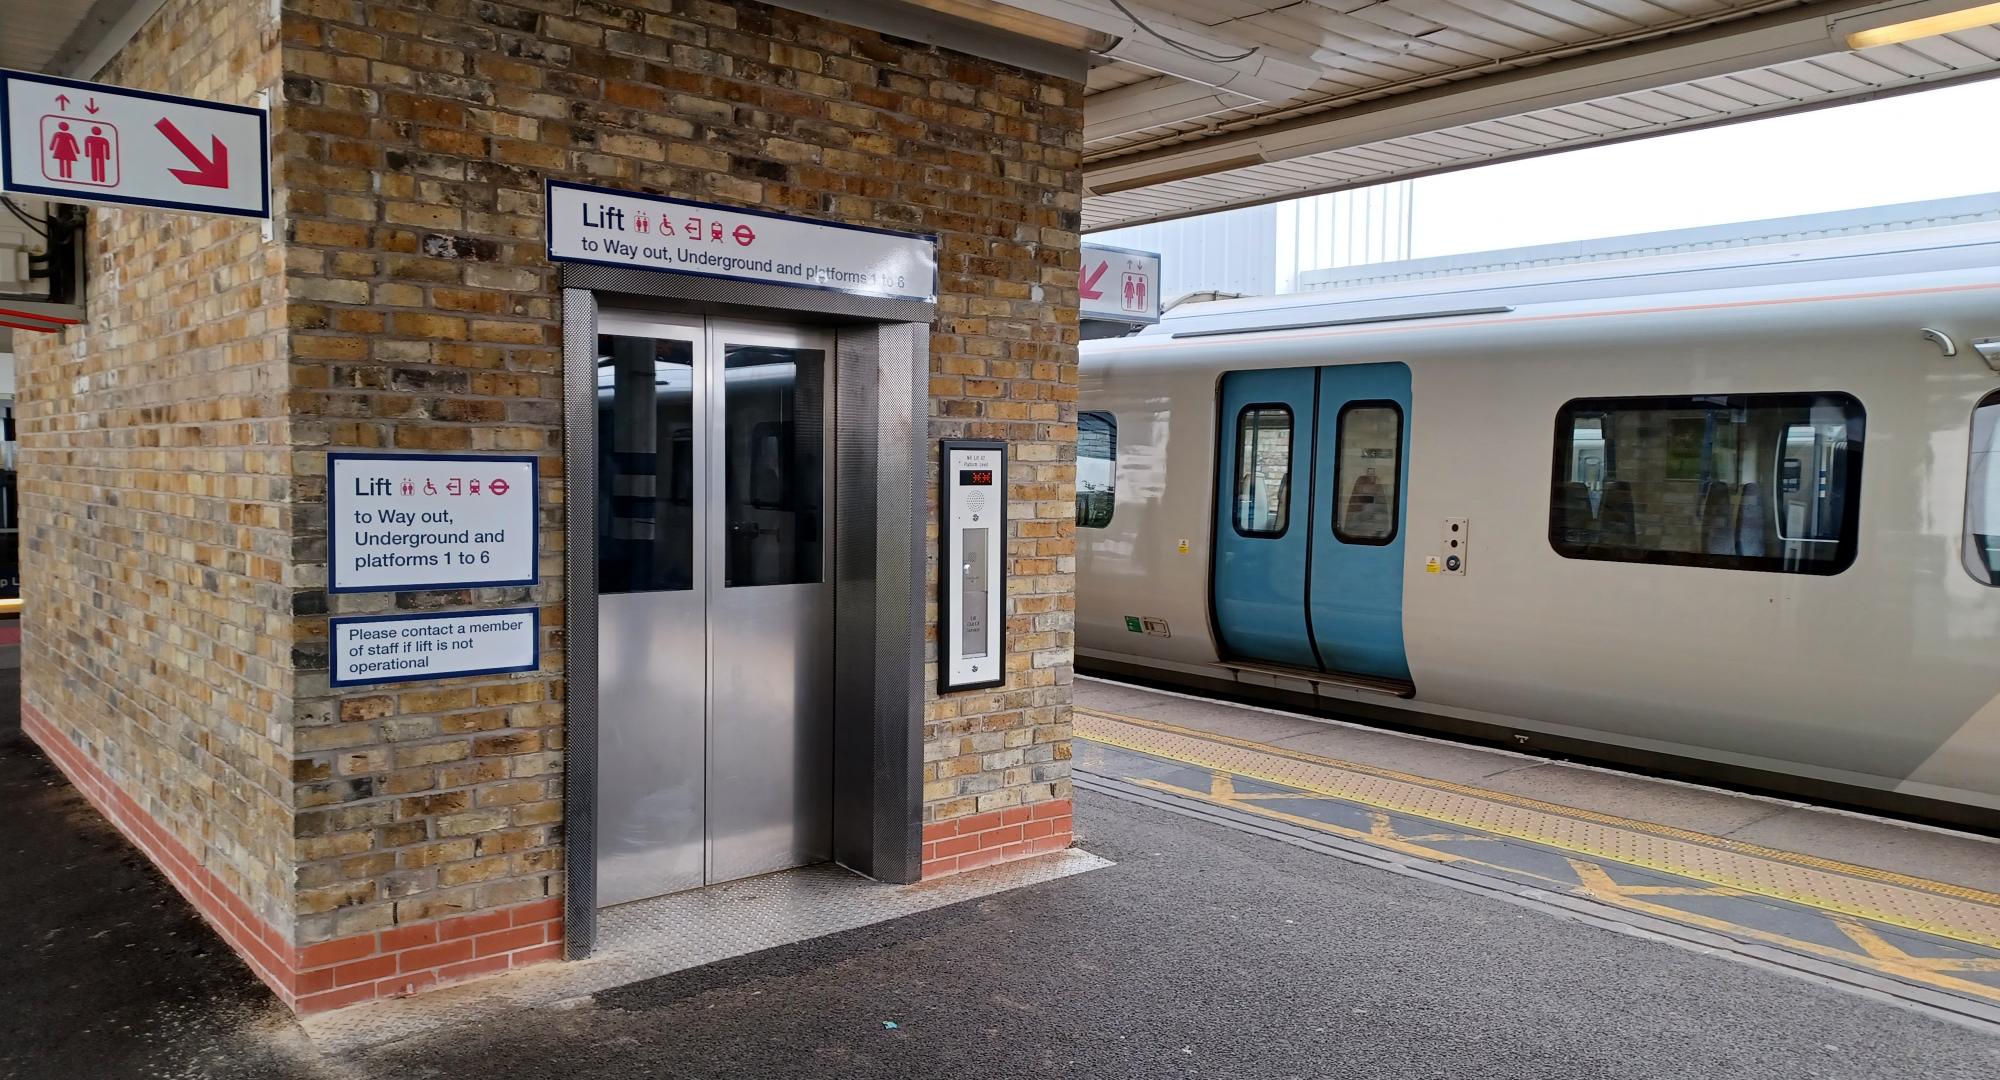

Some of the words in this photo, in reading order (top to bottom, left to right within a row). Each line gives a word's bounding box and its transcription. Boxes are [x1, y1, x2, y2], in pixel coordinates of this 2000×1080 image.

[582, 202, 625, 232] Lift
[582, 236, 598, 253] to
[603, 238, 638, 260] Way
[642, 245, 673, 264] out,
[677, 248, 772, 275] Underground
[776, 260, 802, 277] and
[806, 265, 867, 284] platforms
[870, 273, 876, 286] 1
[882, 275, 895, 288] to
[897, 276, 905, 289] 6
[355, 477, 392, 496] Lift
[354, 510, 372, 524] to
[378, 510, 415, 526] Way
[421, 509, 453, 524] out,
[355, 531, 469, 547] Underground
[474, 530, 505, 543] and
[355, 552, 438, 571] platforms
[444, 552, 452, 565] 1
[458, 552, 475, 565] to
[480, 551, 490, 564] 6
[349, 627, 397, 641] Please
[401, 623, 453, 637] contact
[457, 624, 466, 634] a
[469, 620, 523, 633] member
[349, 645, 364, 656] of
[368, 642, 399, 656] staff
[403, 641, 412, 654] if
[415, 640, 433, 652] lift
[436, 639, 448, 651] is
[452, 638, 474, 650] not
[349, 656, 429, 674] operational
